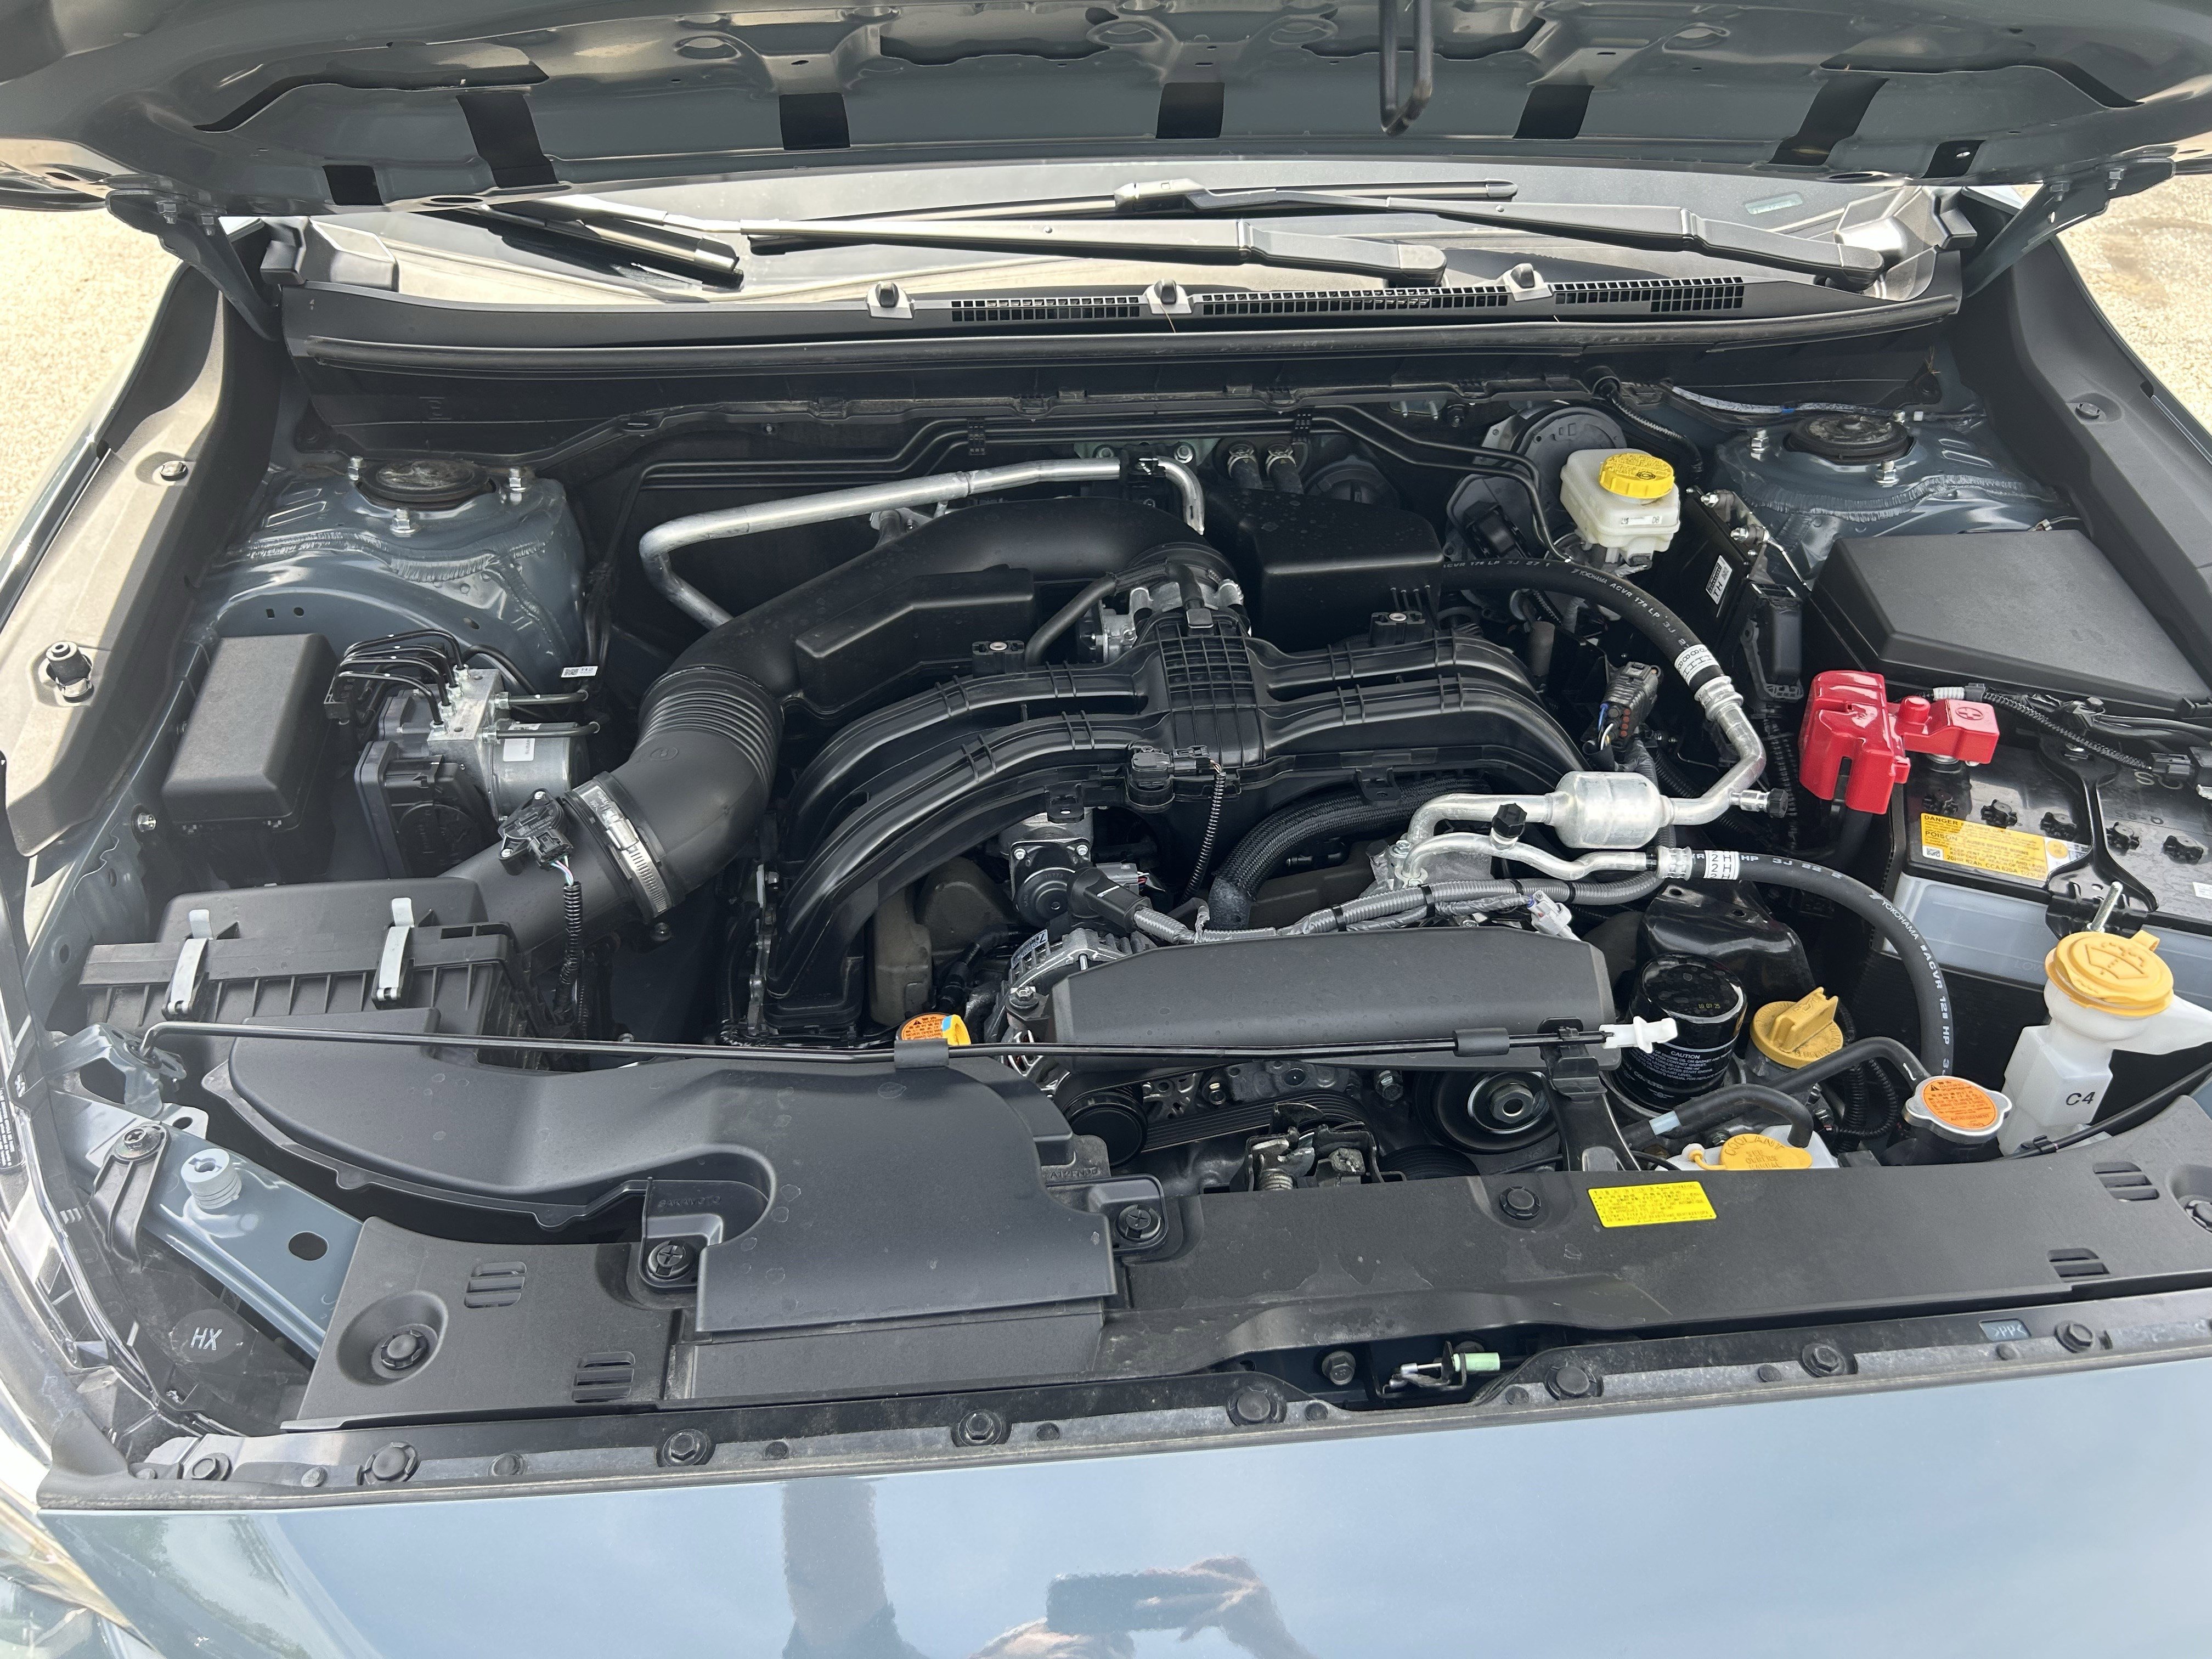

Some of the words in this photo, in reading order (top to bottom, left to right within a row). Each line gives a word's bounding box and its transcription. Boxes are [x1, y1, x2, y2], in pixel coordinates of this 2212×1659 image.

[1579, 571, 1608, 584] YOKOHAMA
[1610, 583, 1633, 597] ACVR
[1648, 608, 1660, 618] LP
[1924, 815, 1959, 826] DANGER
[1925, 831, 1958, 841] POISON
[1772, 857, 1792, 866] 3J
[1882, 900, 1920, 940] YOKOHAMA
[1923, 951, 1943, 989] ACVR
[1943, 1026, 1950, 1045] HP
[1671, 1050, 1701, 1059] CAUTION
[2066, 1091, 2096, 1106] C4
[1724, 1135, 1785, 1156] COOLANT
[190, 1327, 223, 1351] HX
